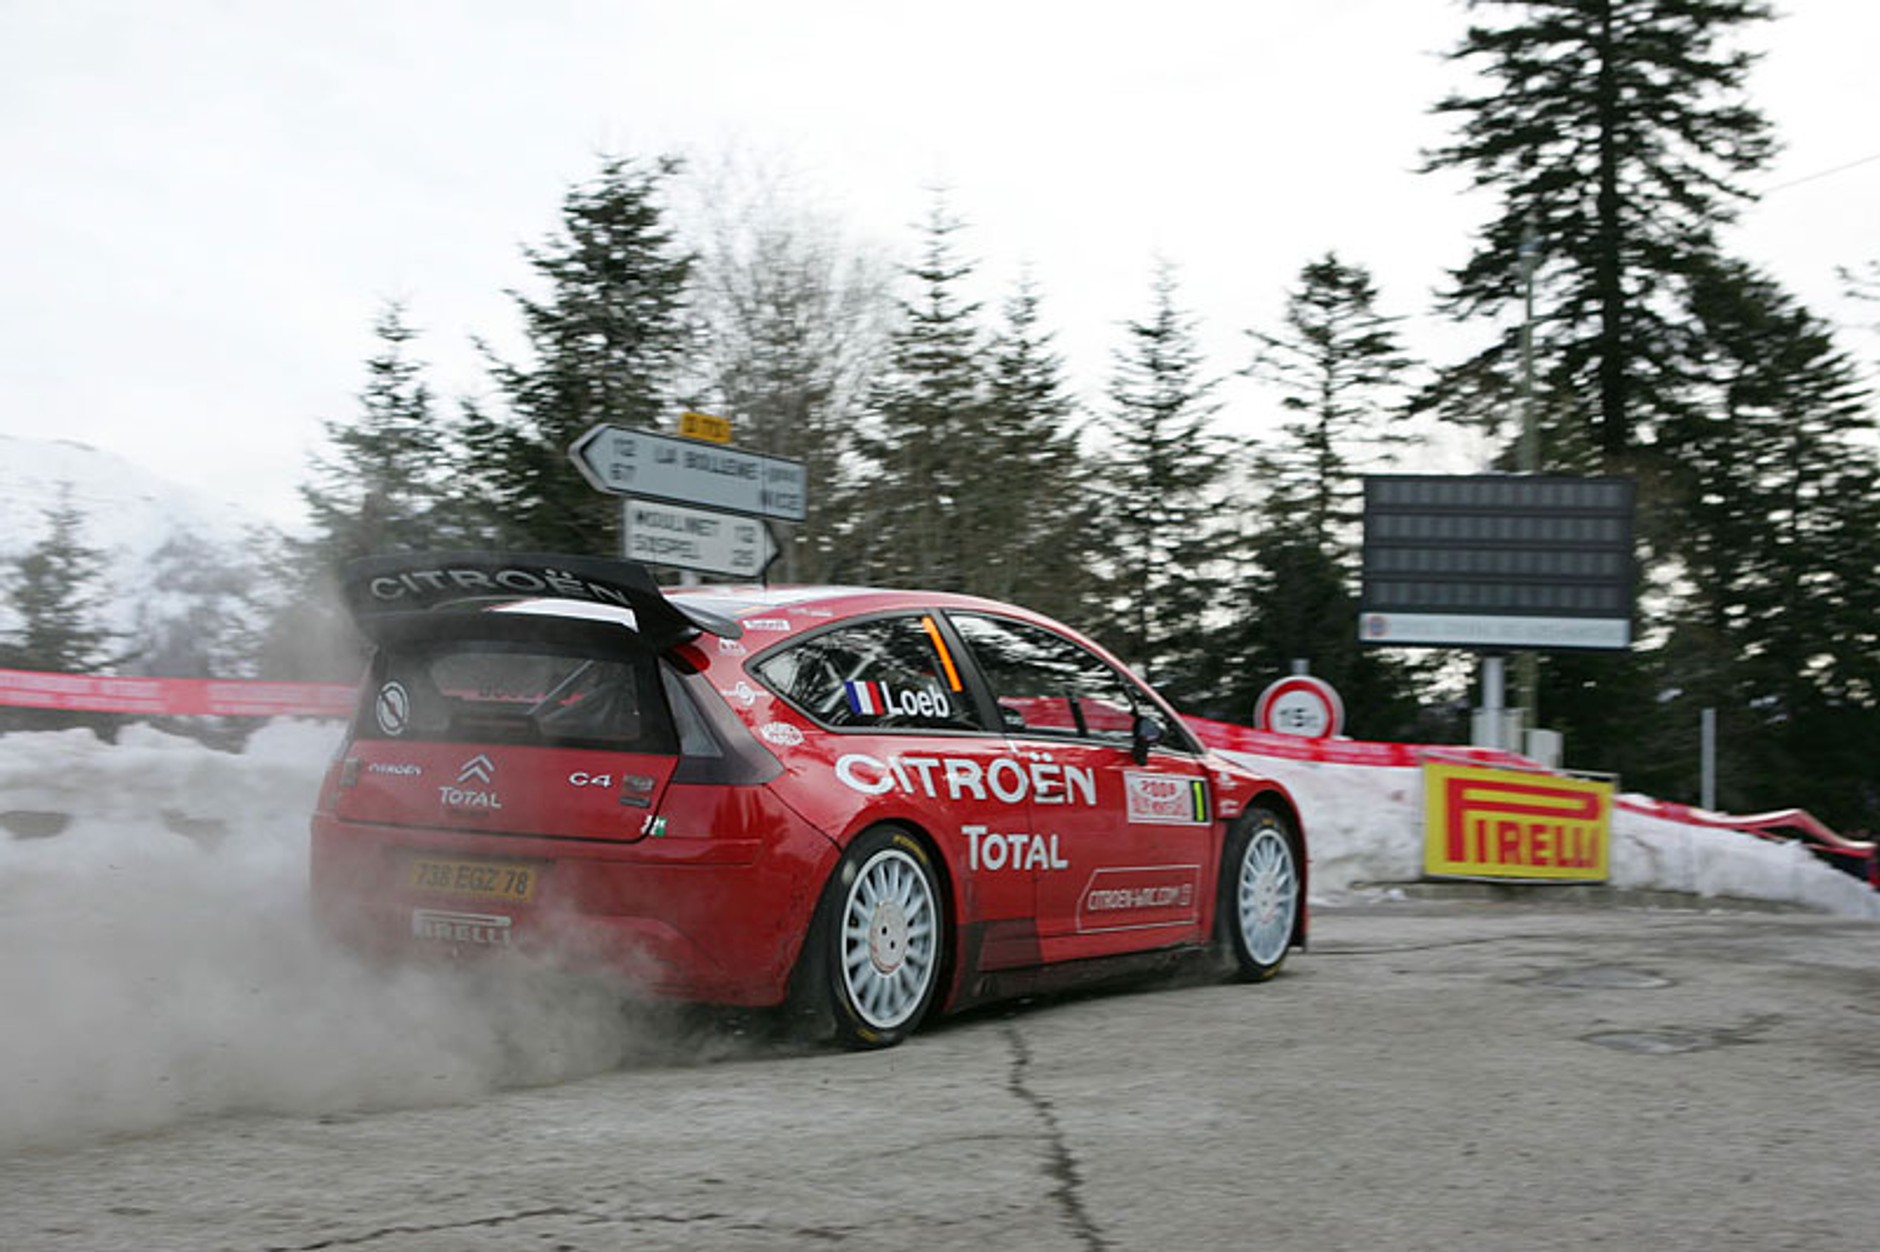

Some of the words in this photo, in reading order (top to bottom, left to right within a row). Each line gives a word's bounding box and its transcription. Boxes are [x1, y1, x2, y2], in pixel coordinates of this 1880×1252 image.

[369, 568, 632, 606] CITROËN
[879, 680, 949, 718] Loeb
[568, 771, 613, 788] C4
[834, 751, 1097, 805] CITROËN
[1193, 781, 1205, 822] 1
[416, 861, 452, 887] 738
[454, 864, 500, 892] EGZ
[503, 868, 529, 896] 78
[413, 908, 512, 945] PIRELLI
